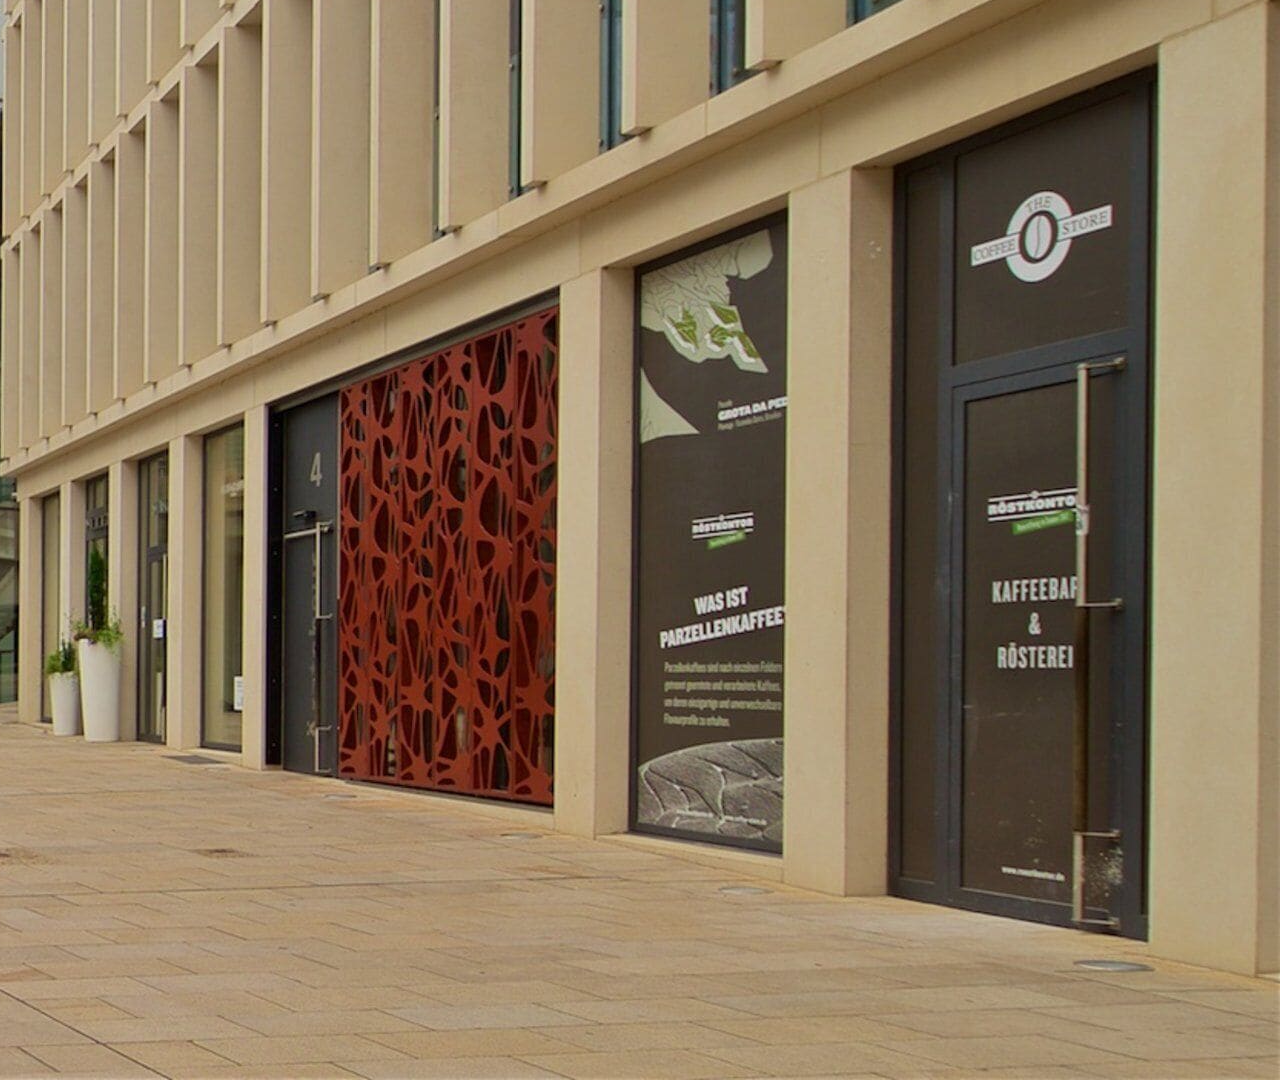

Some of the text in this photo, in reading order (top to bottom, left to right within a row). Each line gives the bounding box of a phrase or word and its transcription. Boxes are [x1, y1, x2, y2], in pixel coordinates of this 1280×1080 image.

[1025, 196, 1053, 213] THE
[974, 210, 1109, 261] COFFEE STORE
[310, 452, 322, 487] 4
[988, 495, 1076, 516] RÖSTKONTO
[694, 586, 748, 615] WAS IST
[659, 605, 785, 649] PARZELLENKAFFEE
[1028, 612, 1041, 635] &
[997, 642, 1074, 669] RÖSTEREI
